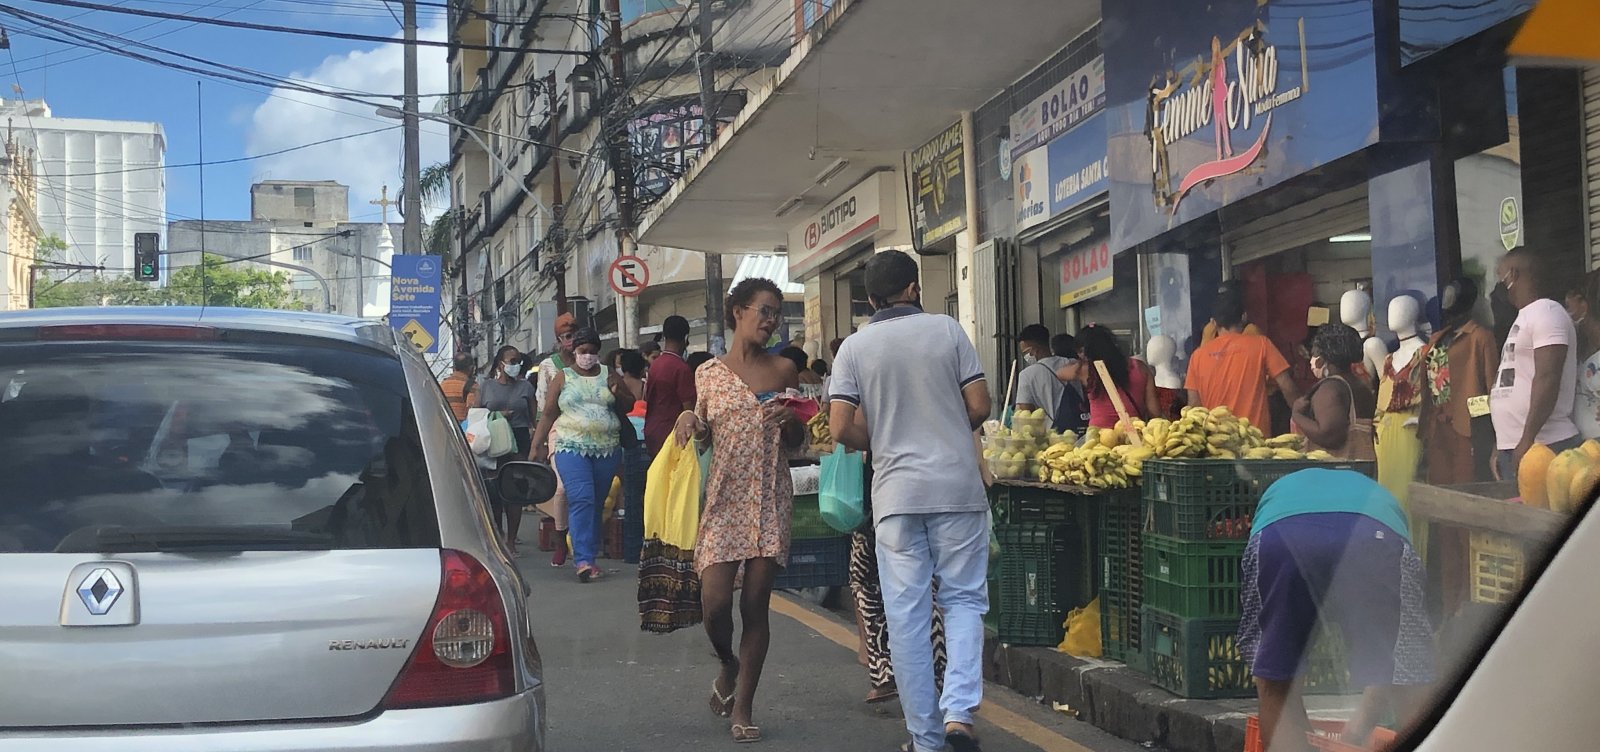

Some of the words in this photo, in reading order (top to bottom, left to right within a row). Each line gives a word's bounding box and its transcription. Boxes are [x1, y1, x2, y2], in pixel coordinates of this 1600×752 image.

[1055, 172, 1080, 203] LOTERIA
[1081, 160, 1102, 190] SANTA
[821, 196, 856, 235] BIOTIPO
[392, 277, 419, 285] Nova
[392, 285, 435, 293] Avenida
[392, 293, 416, 301] Sete
[328, 638, 411, 651] RENAULT
